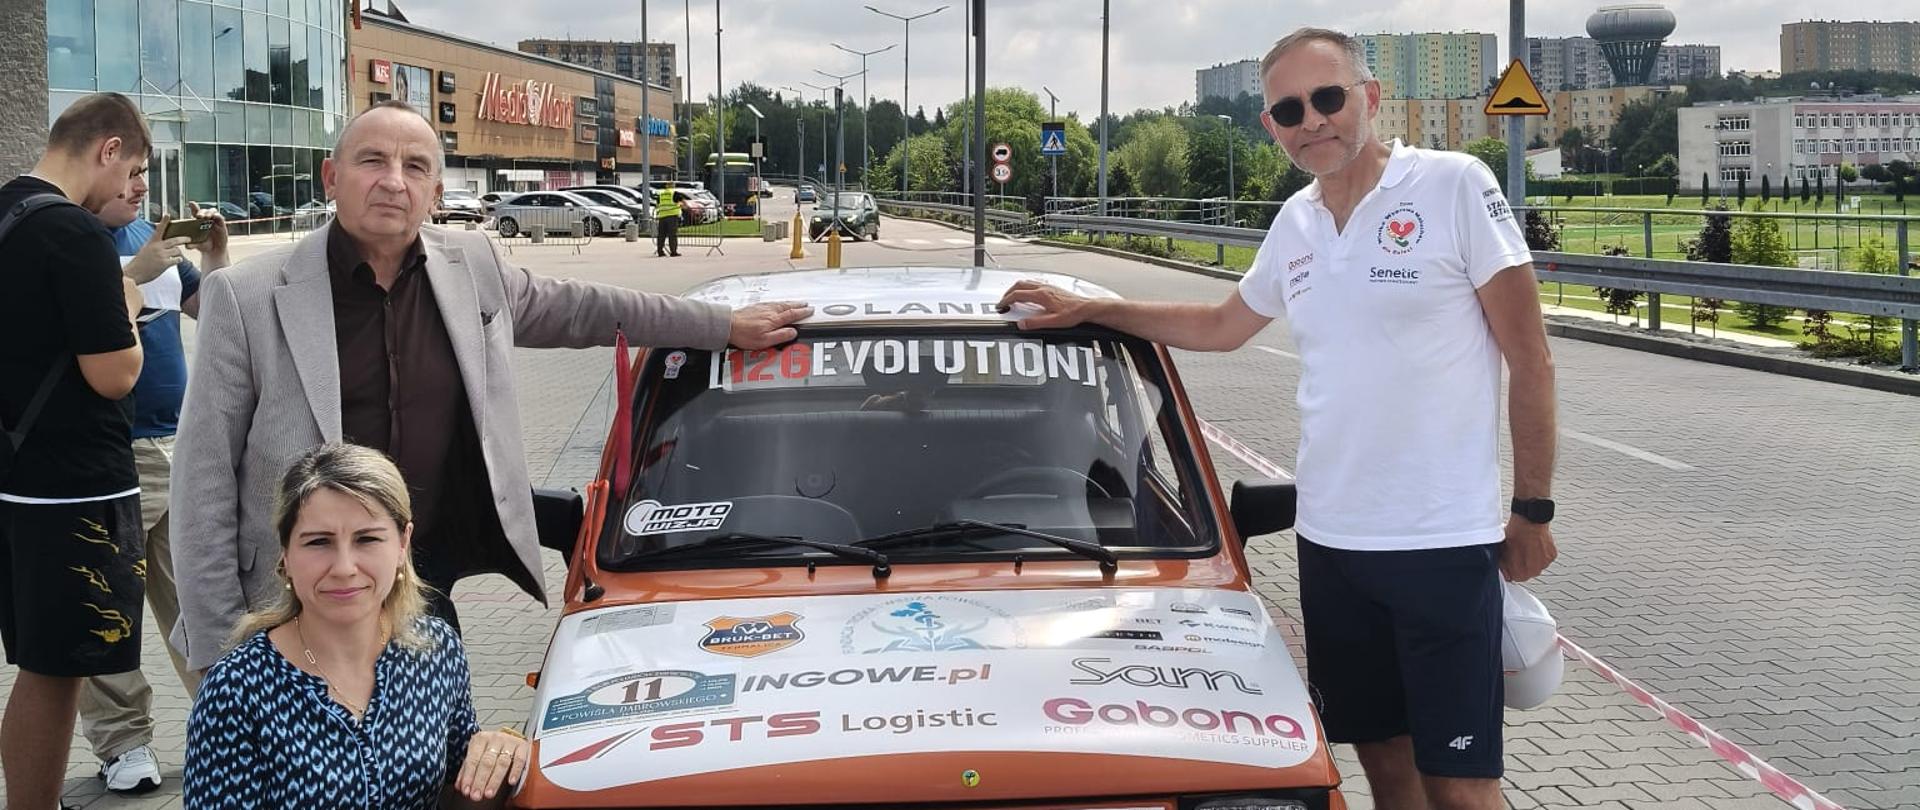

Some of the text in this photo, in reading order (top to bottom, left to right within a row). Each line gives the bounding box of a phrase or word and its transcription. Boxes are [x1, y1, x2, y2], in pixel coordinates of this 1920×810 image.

[1369, 267, 1420, 280] Senetic
[822, 302, 1001, 316] OLAND
[650, 504, 730, 521] MOTO
[709, 631, 793, 644] BRUK-BET
[742, 664, 991, 693] INGOWE.pl
[621, 678, 663, 704] 11
[842, 708, 998, 734] Logistic
[1043, 697, 1306, 741] Gabona
[650, 711, 821, 751] STS
[1242, 734, 1309, 752] SUPPLIER
[1449, 735, 1473, 750] 4F
